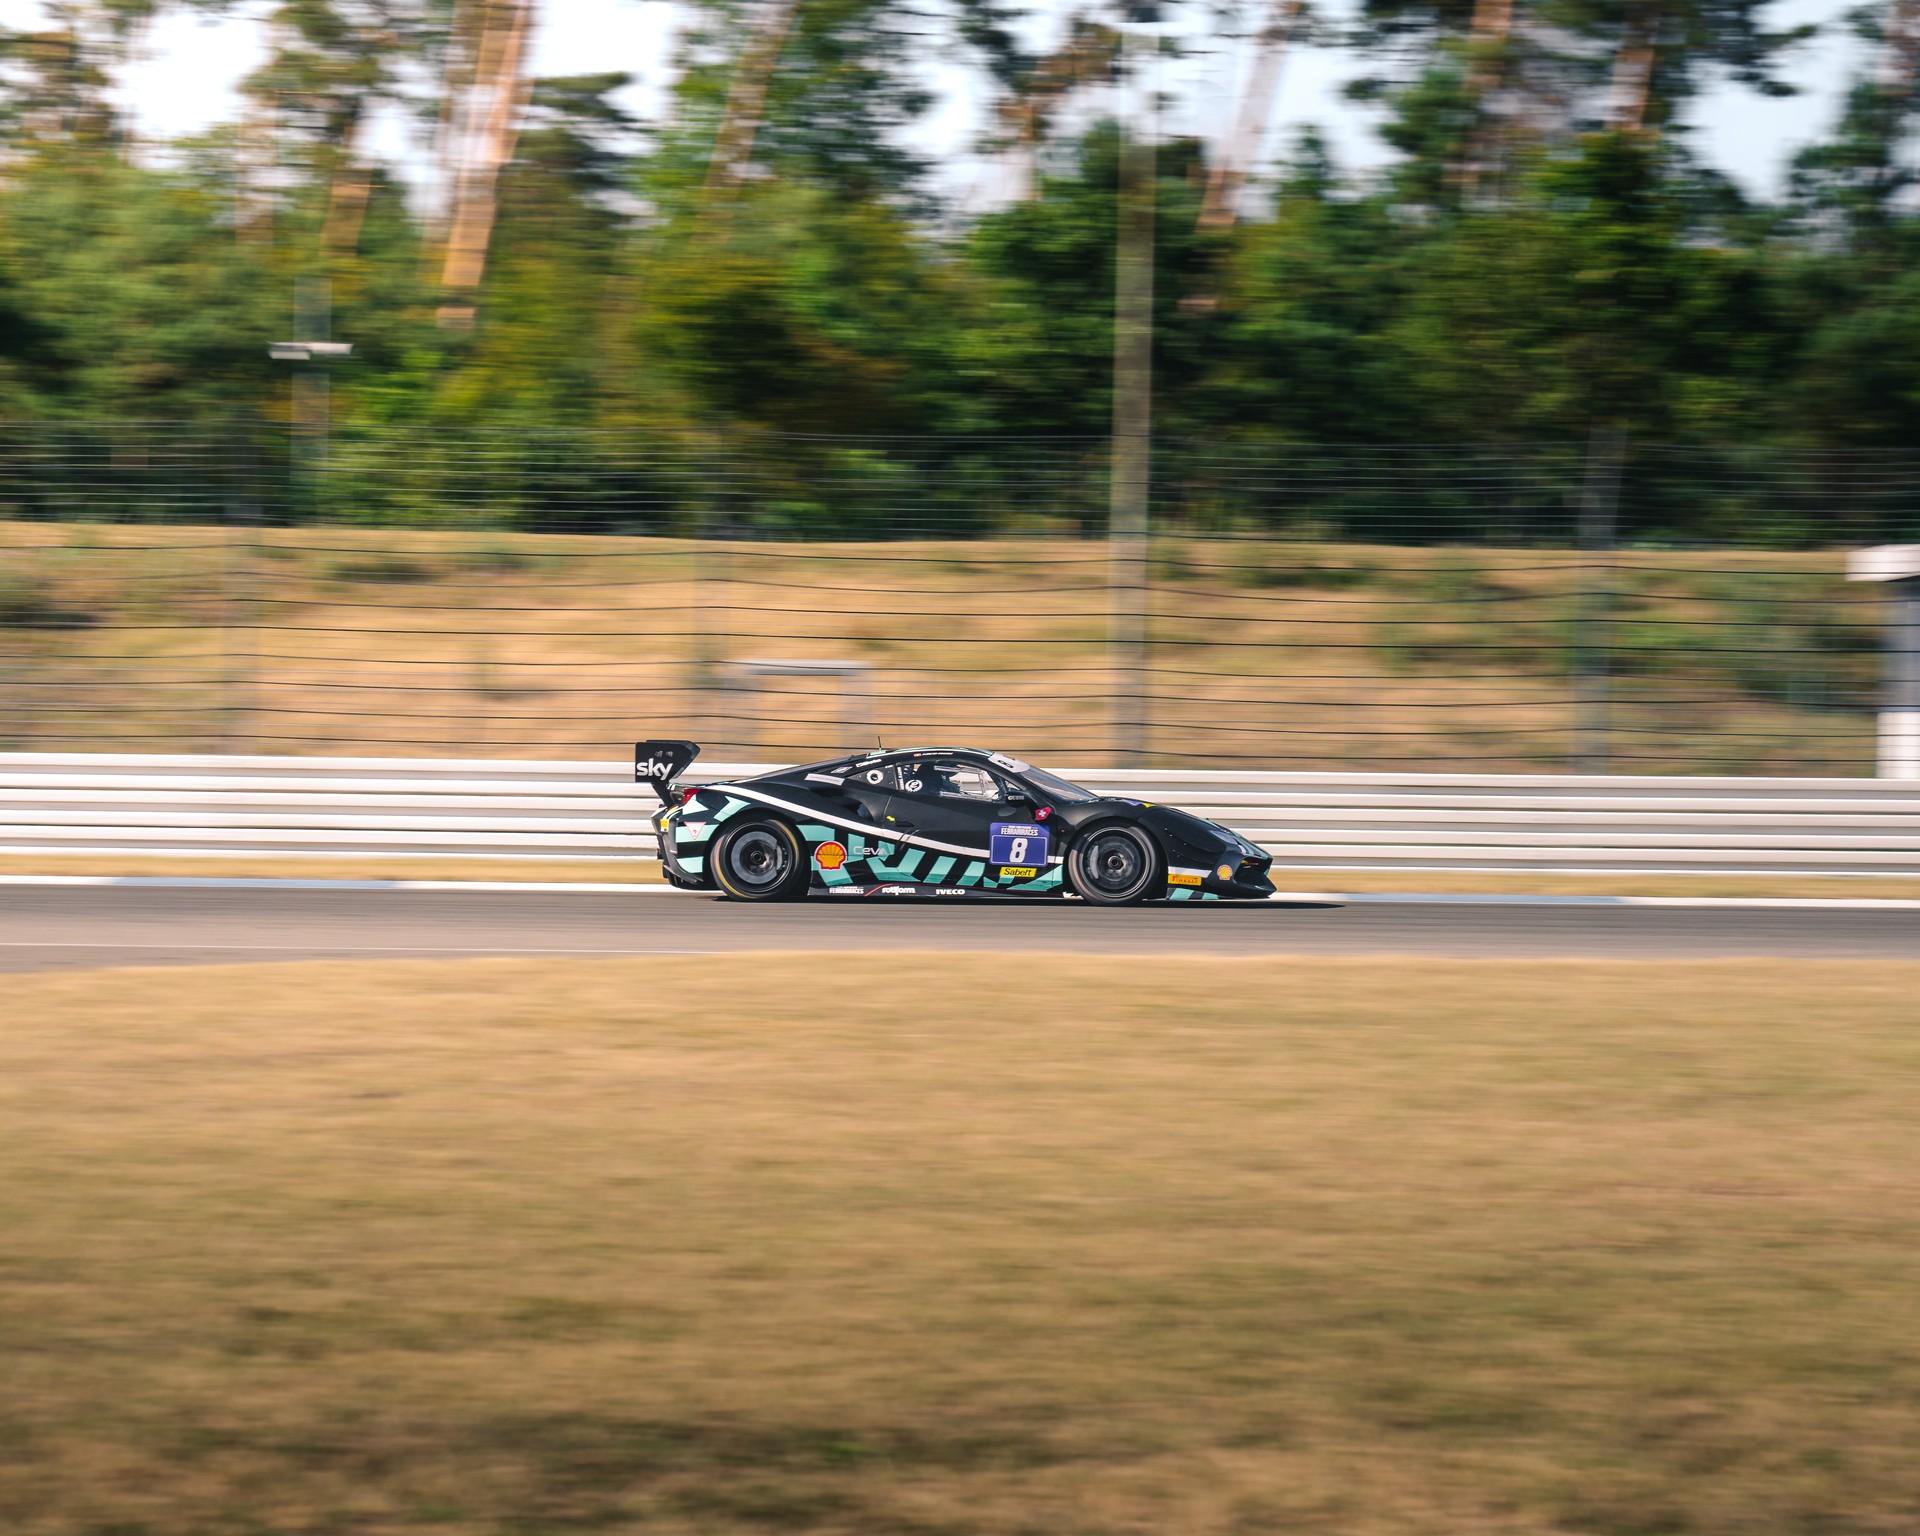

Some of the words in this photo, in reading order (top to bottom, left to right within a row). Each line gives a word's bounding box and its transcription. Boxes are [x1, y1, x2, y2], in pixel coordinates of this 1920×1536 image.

[636, 758, 673, 781] sky
[1009, 837, 1028, 863] 8
[1003, 867, 1032, 876] Sabelt
